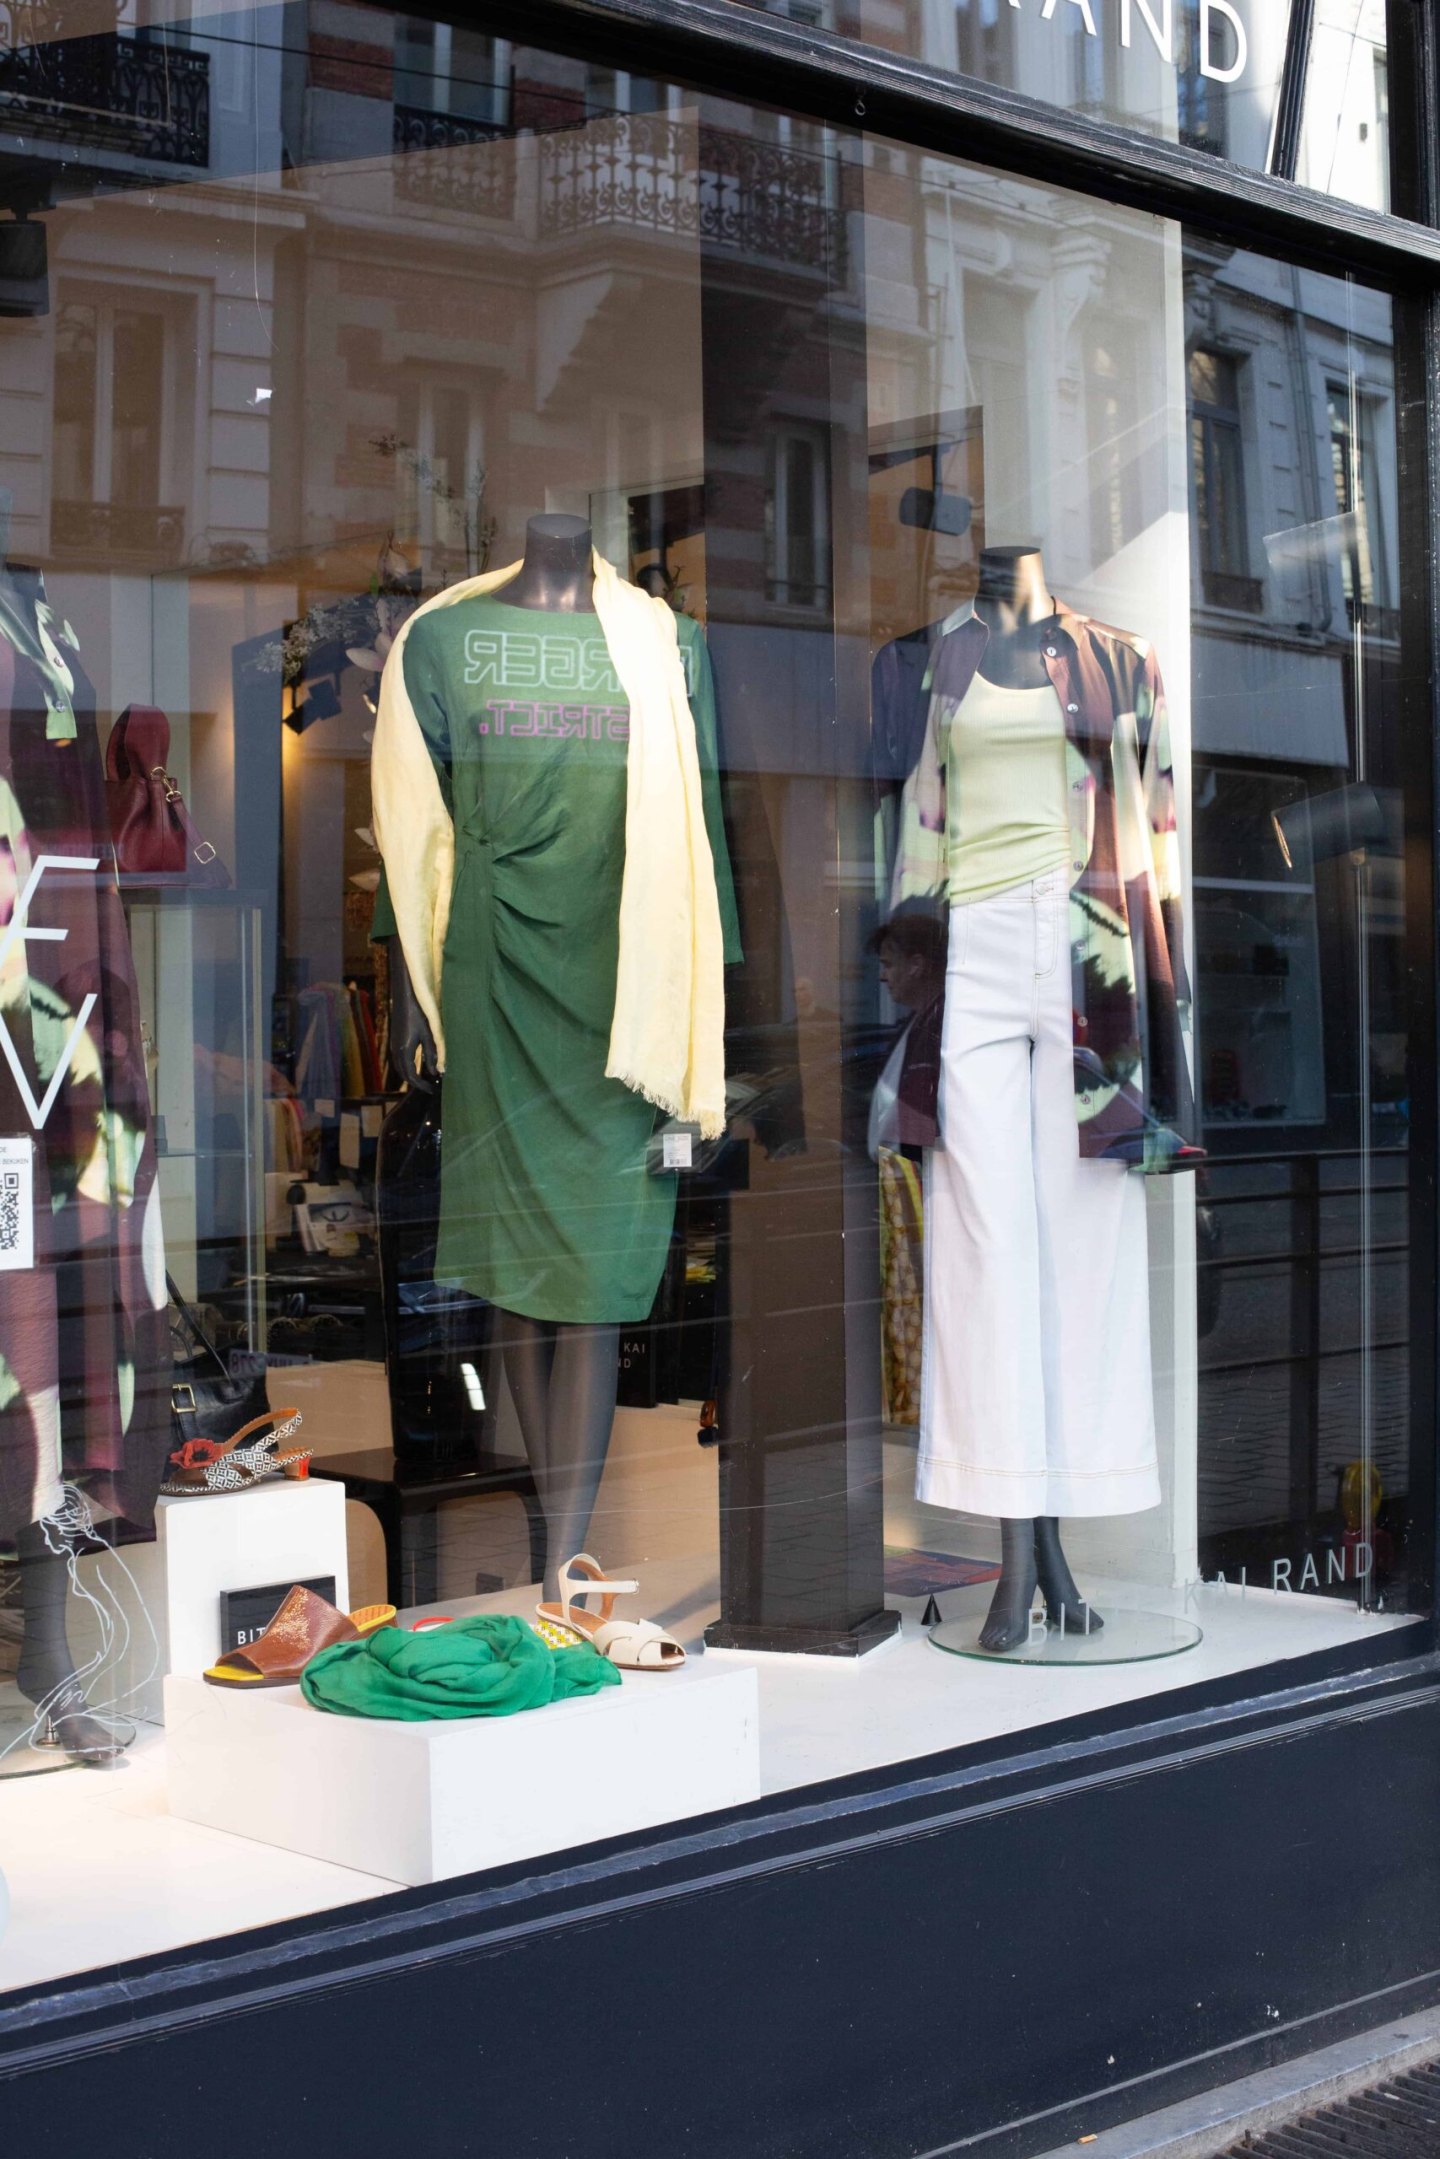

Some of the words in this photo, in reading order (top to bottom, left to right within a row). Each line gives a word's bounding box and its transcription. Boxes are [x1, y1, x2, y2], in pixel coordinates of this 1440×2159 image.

[623, 1342, 646, 1354] KAI
[1273, 1542, 1374, 1596] RAND
[237, 1627, 267, 1646] BIT
